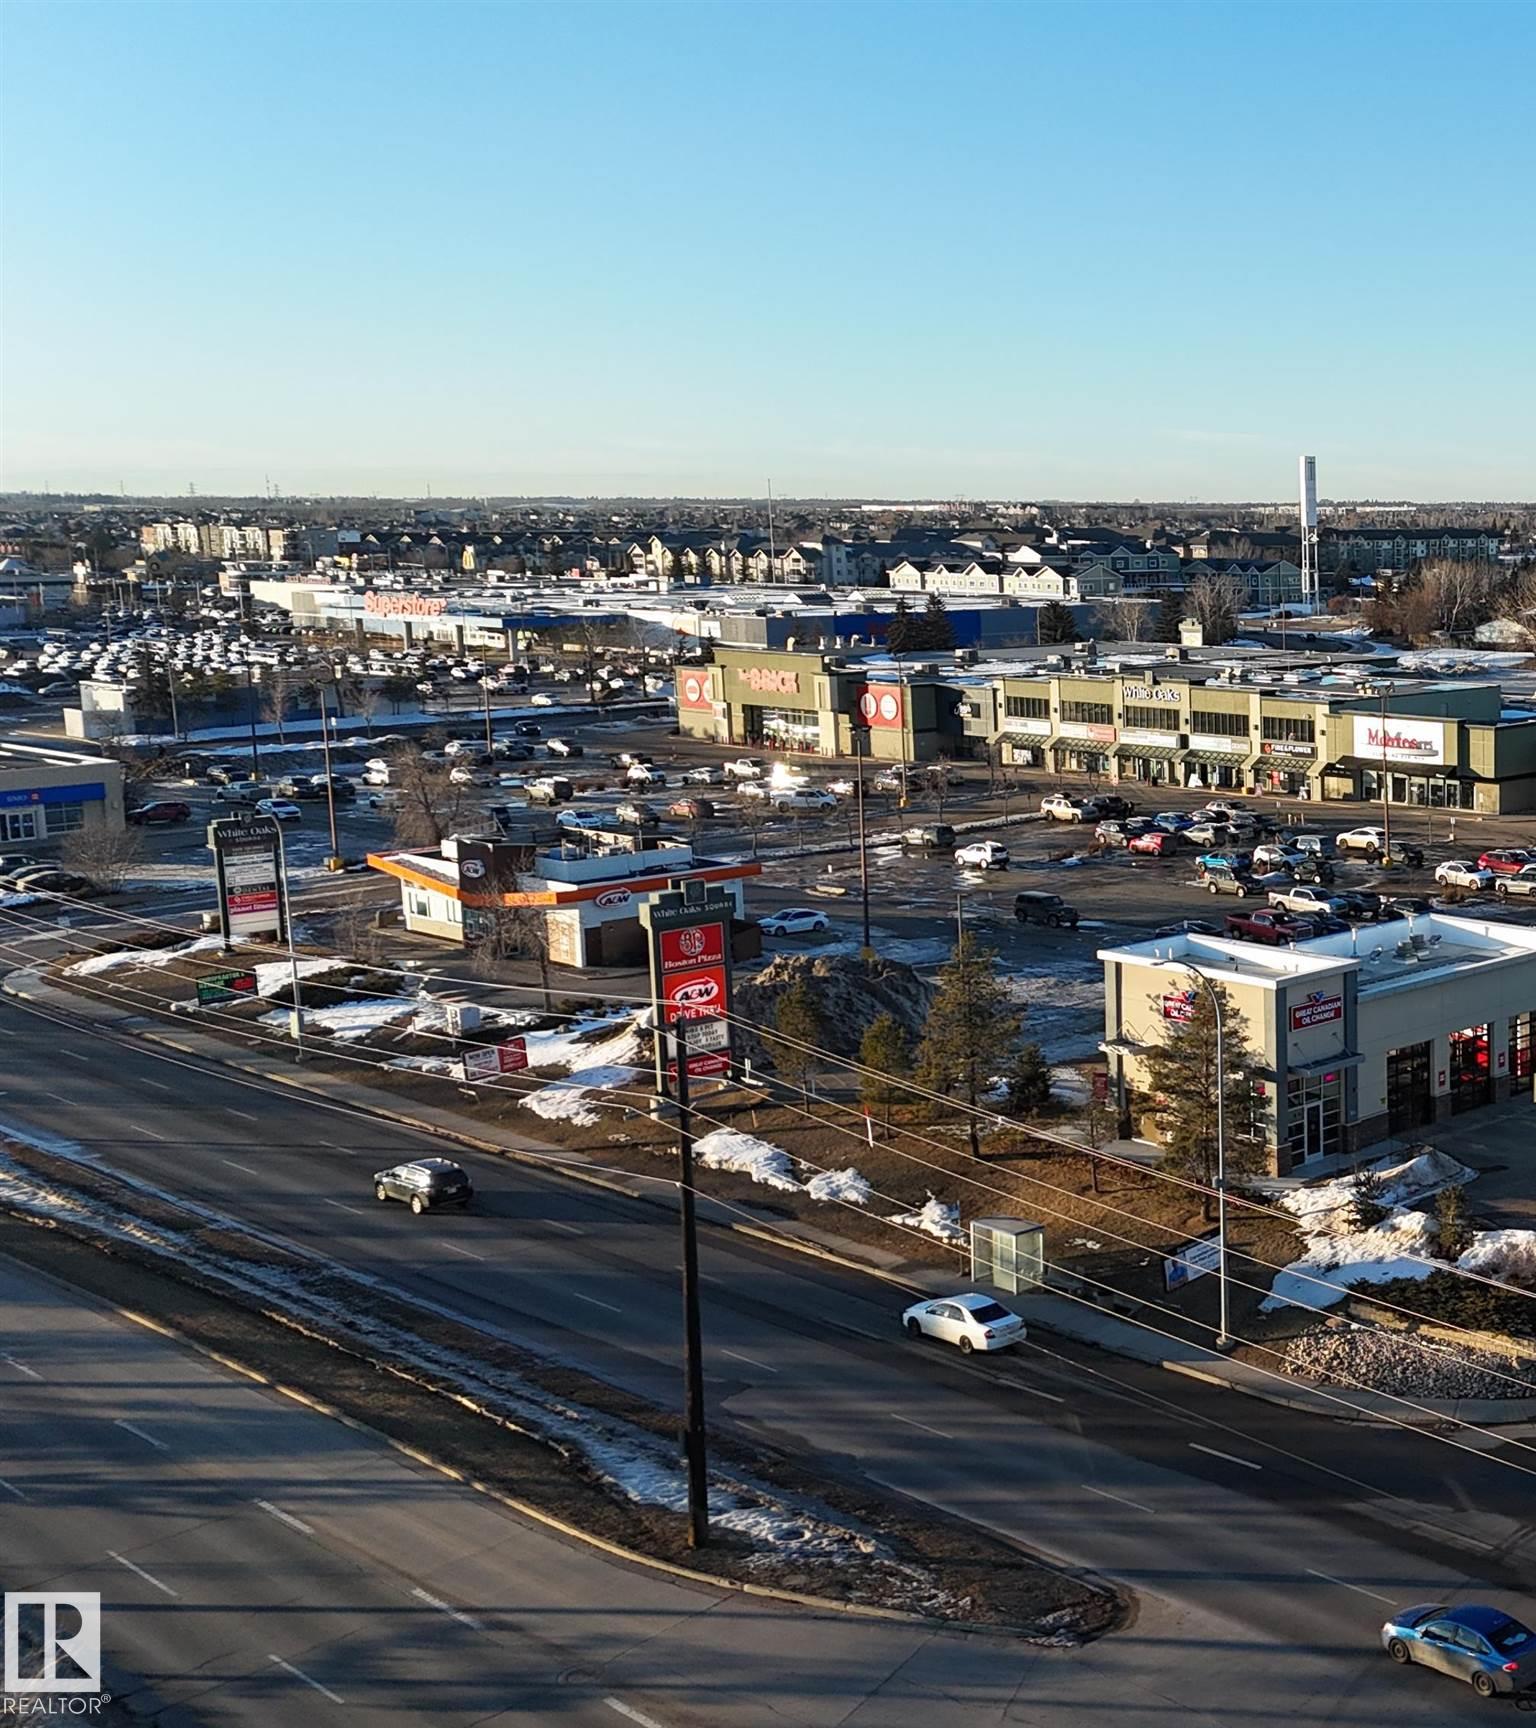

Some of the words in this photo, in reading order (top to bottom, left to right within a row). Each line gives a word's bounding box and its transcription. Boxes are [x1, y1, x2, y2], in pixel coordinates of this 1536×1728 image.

[364, 591, 442, 616] Superstore
[1123, 686, 1153, 700] White
[1154, 689, 1181, 702] Oaks
[653, 908, 678, 919] White
[664, 958, 697, 970] Boston
[697, 953, 722, 965] Pizza
[680, 985, 714, 1001] A&W
